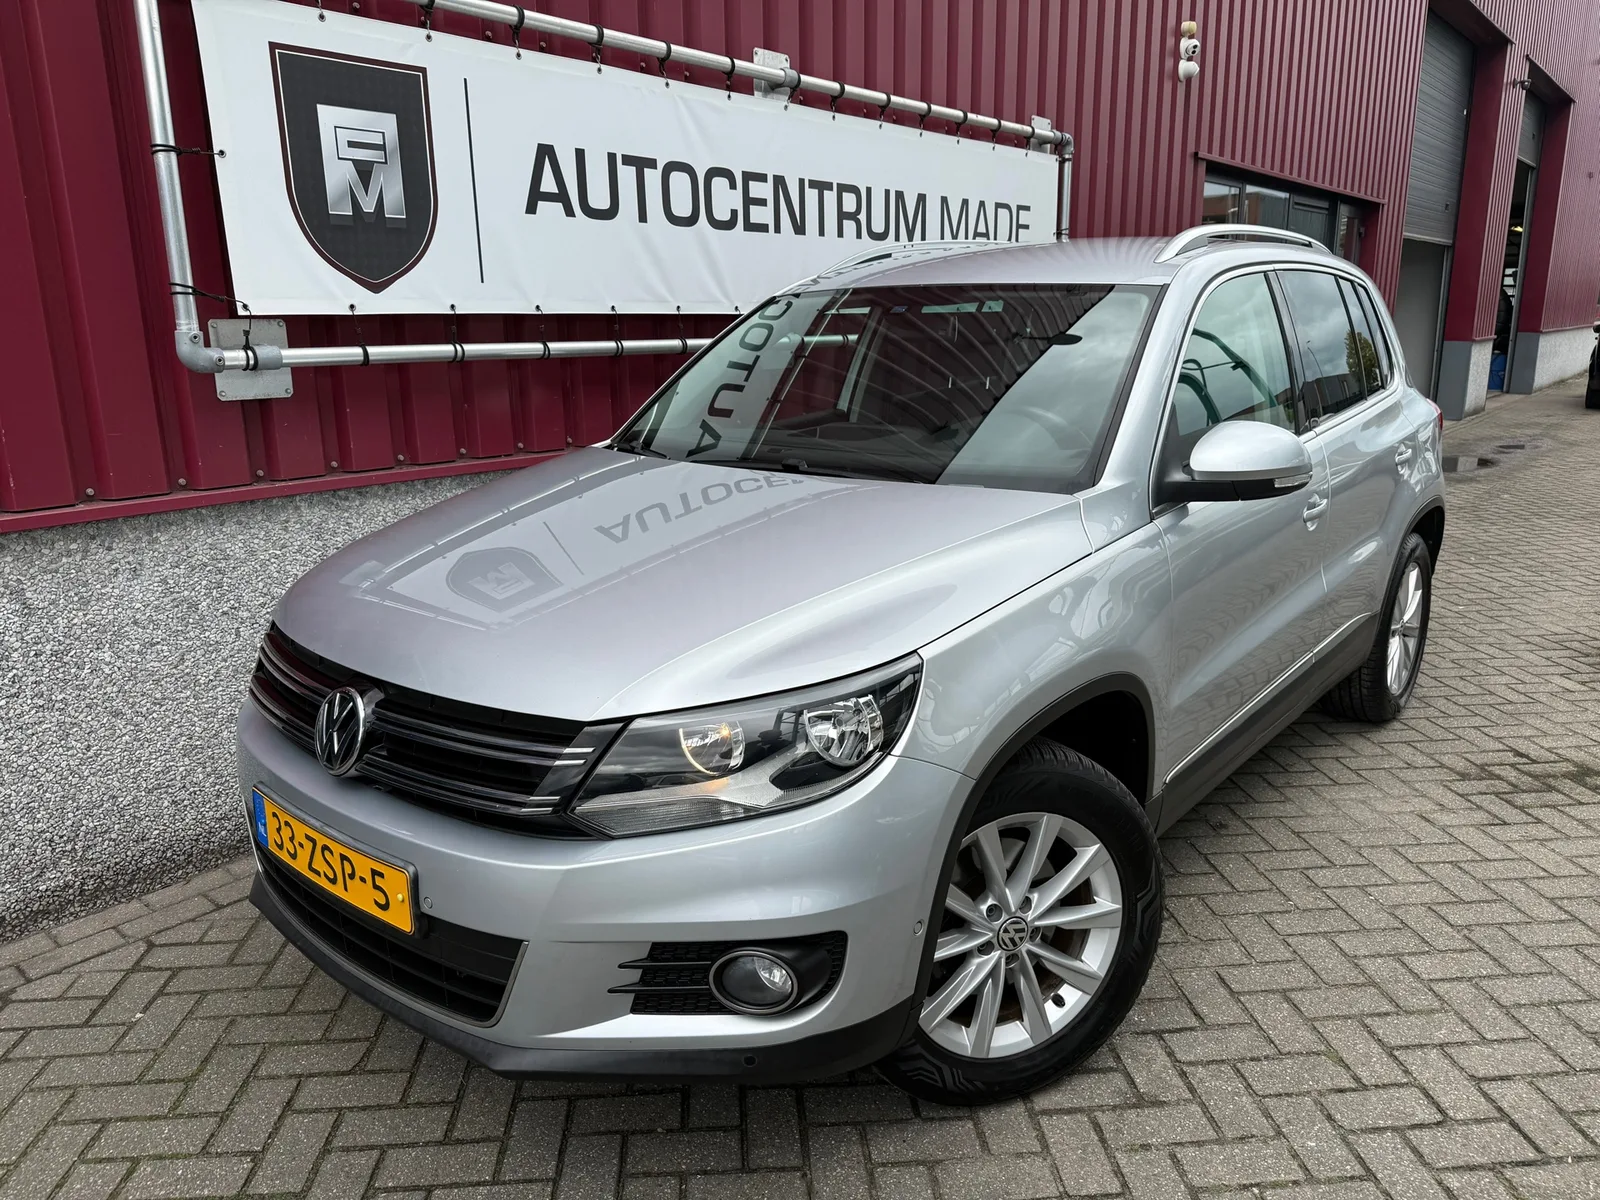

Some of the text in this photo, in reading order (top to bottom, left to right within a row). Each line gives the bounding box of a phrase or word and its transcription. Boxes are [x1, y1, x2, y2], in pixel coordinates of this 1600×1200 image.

[524, 143, 1031, 243] AUTOCENTRUM MADE
[271, 811, 391, 911] 33-ZSP-5
